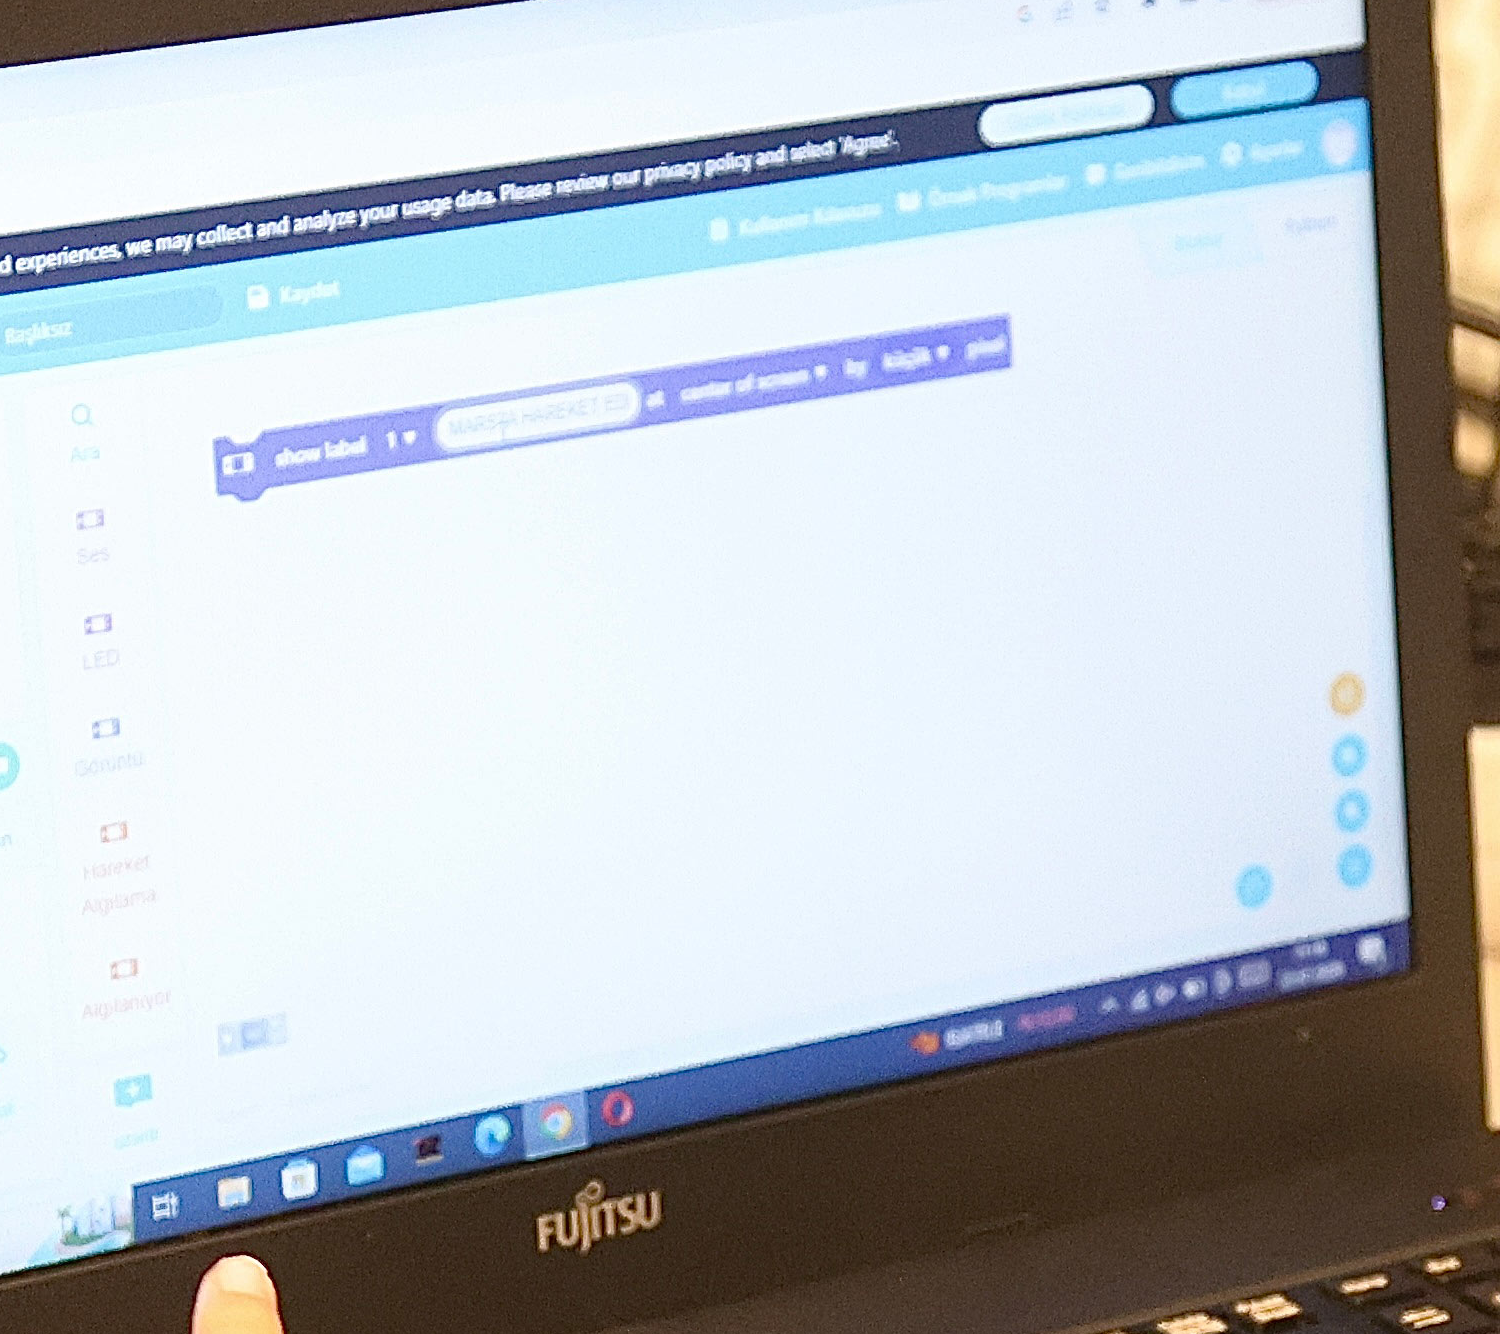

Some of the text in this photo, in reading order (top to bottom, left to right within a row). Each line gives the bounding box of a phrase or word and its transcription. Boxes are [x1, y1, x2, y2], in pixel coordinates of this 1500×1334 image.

[16, 242, 123, 275] experiences,
[125, 237, 153, 258] we
[155, 231, 194, 257] may
[196, 221, 253, 249] collect
[256, 215, 291, 239] and
[293, 208, 358, 234] analyze
[359, 202, 400, 227] your
[401, 195, 452, 220] usage
[455, 187, 496, 209] data.
[500, 180, 552, 205] Please
[555, 173, 609, 197] review
[612, 169, 642, 190] our
[644, 161, 701, 188] privacy
[704, 151, 752, 179] policy
[755, 144, 790, 169] and
[791, 138, 837, 164] select
[279, 280, 340, 305] Kaydet
[275, 447, 320, 468] show
[324, 434, 368, 458] label
[82, 648, 121, 670] LED
[537, 1180, 661, 1257] FUJITSU
